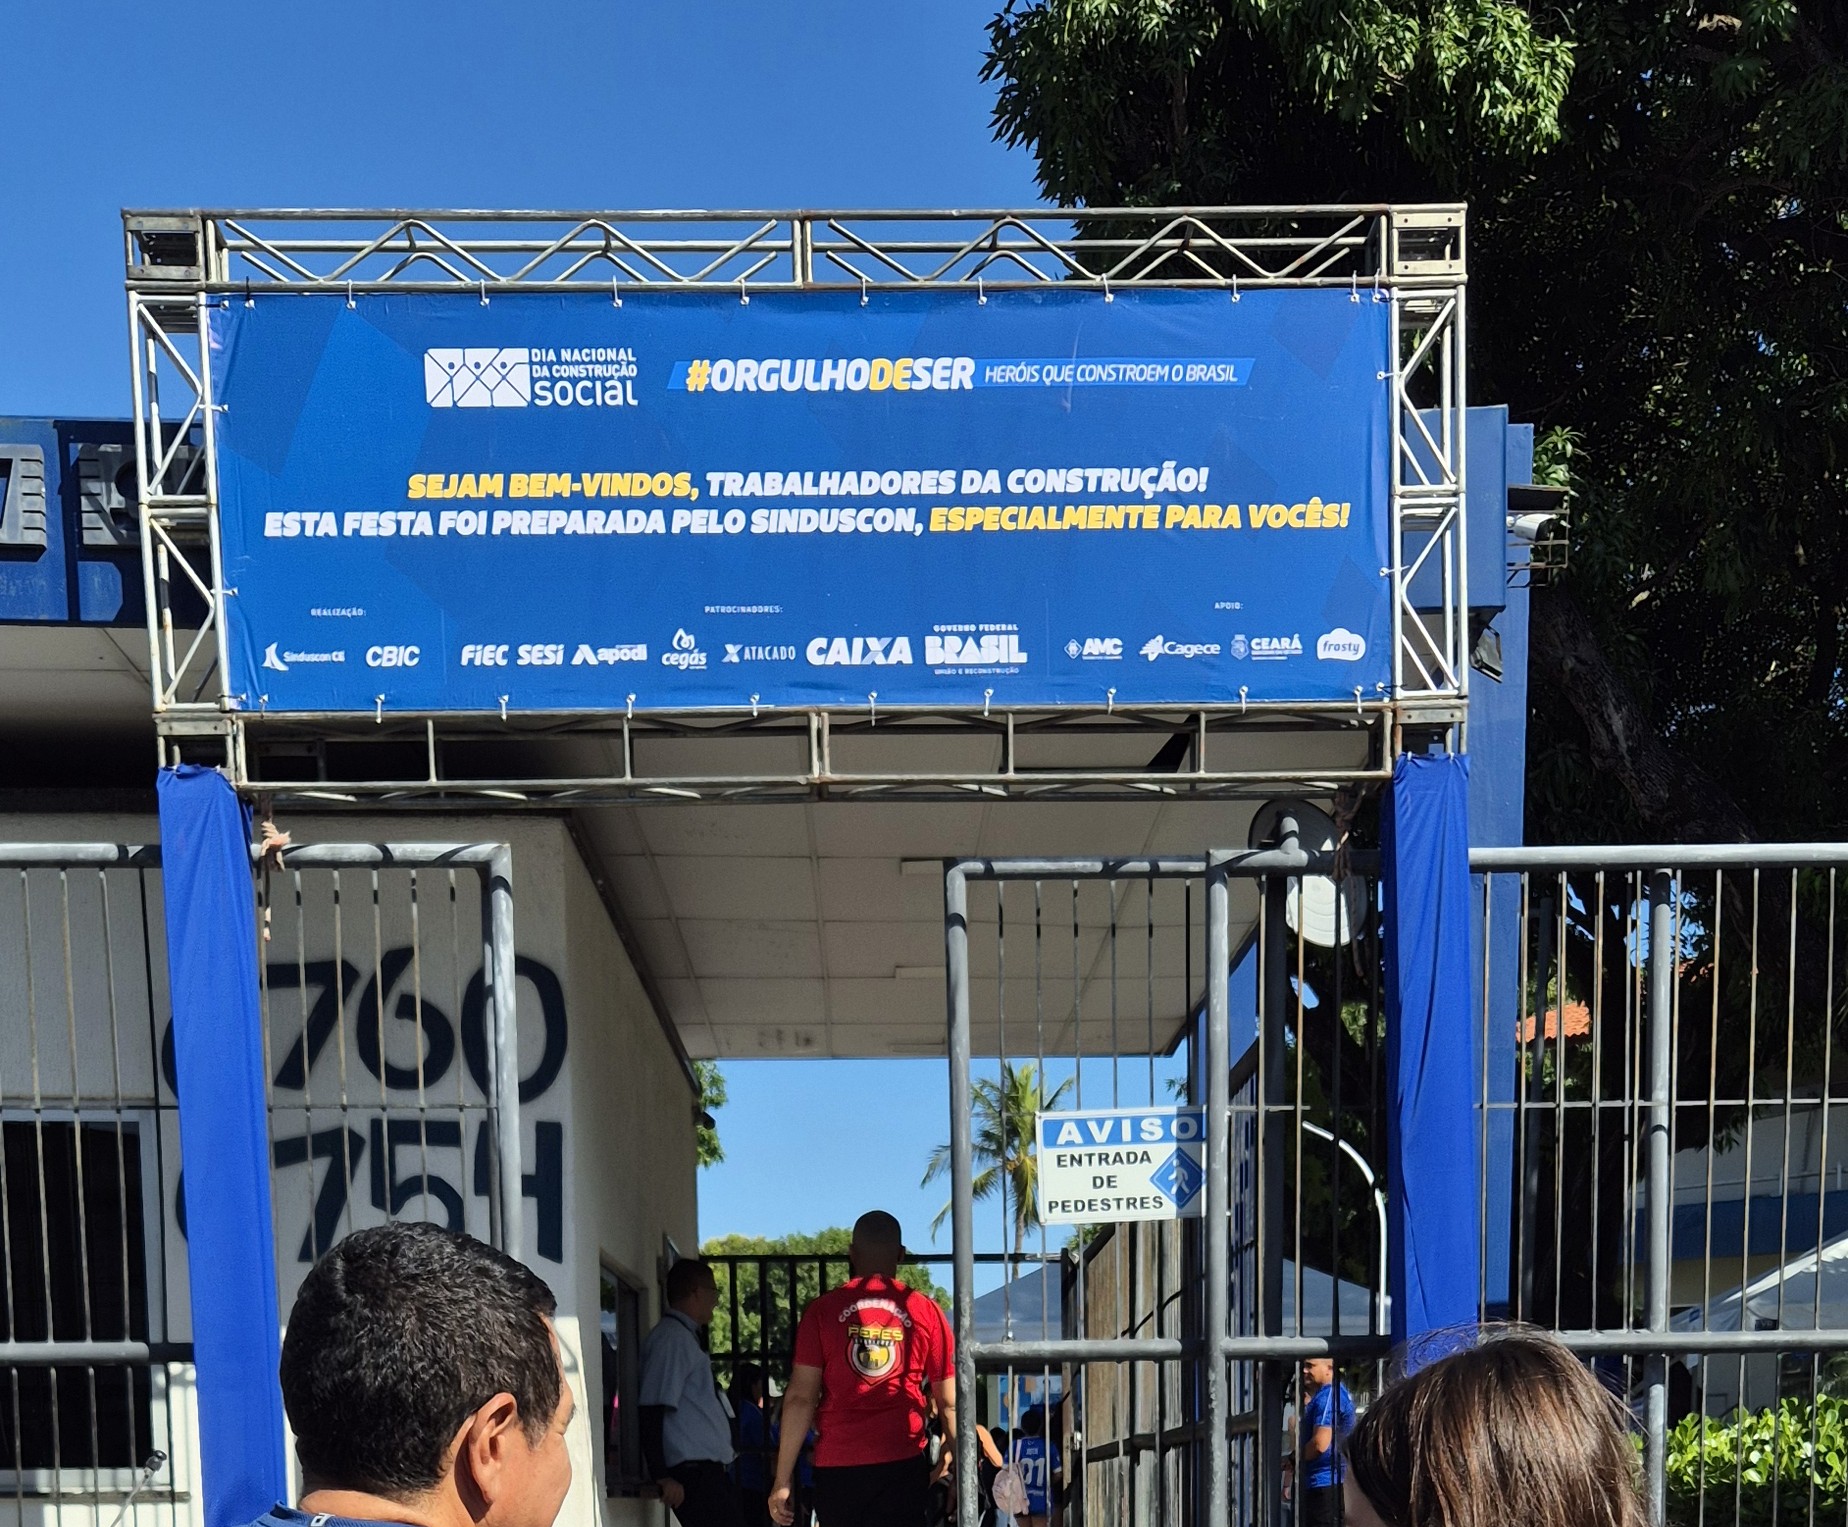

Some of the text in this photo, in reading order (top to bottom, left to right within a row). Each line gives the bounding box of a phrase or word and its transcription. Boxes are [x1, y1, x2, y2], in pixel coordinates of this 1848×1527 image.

[531, 347, 637, 363] DIA NACIONAL
[532, 361, 638, 379] DA CONSTRUÇÃO
[685, 356, 976, 392] #ORGULHODESER
[985, 361, 1238, 385] HERÓIS QUE CONSTROEM O BRASIL
[407, 462, 1210, 502] SEJAM BEM-VINDOS, TRABALHADORES DA CONSTRUÇÃO!
[263, 496, 1351, 537] ESTA FESTA FOI PREPARADA PELO SINDUSCON, ESPECIALMENTE PARA VOCÊS!
[932, 623, 1019, 633] GOVERNO FEDERAL
[806, 636, 913, 666] CAIXA
[924, 634, 1028, 665] BRASIL
[1081, 637, 1123, 656] AMC
[1163, 641, 1221, 659] Cagece
[1250, 633, 1303, 651] CEARÁ
[1322, 641, 1361, 655] frosty
[365, 645, 421, 667] CBIC
[743, 645, 796, 661] ATACADO
[162, 947, 568, 1105] 760
[1056, 1116, 1199, 1146] AVISO
[1056, 1150, 1152, 1168] ENTRADA
[176, 1118, 563, 1264] 754
[1092, 1174, 1118, 1190] DE
[1048, 1195, 1164, 1214] PEDESTRES
